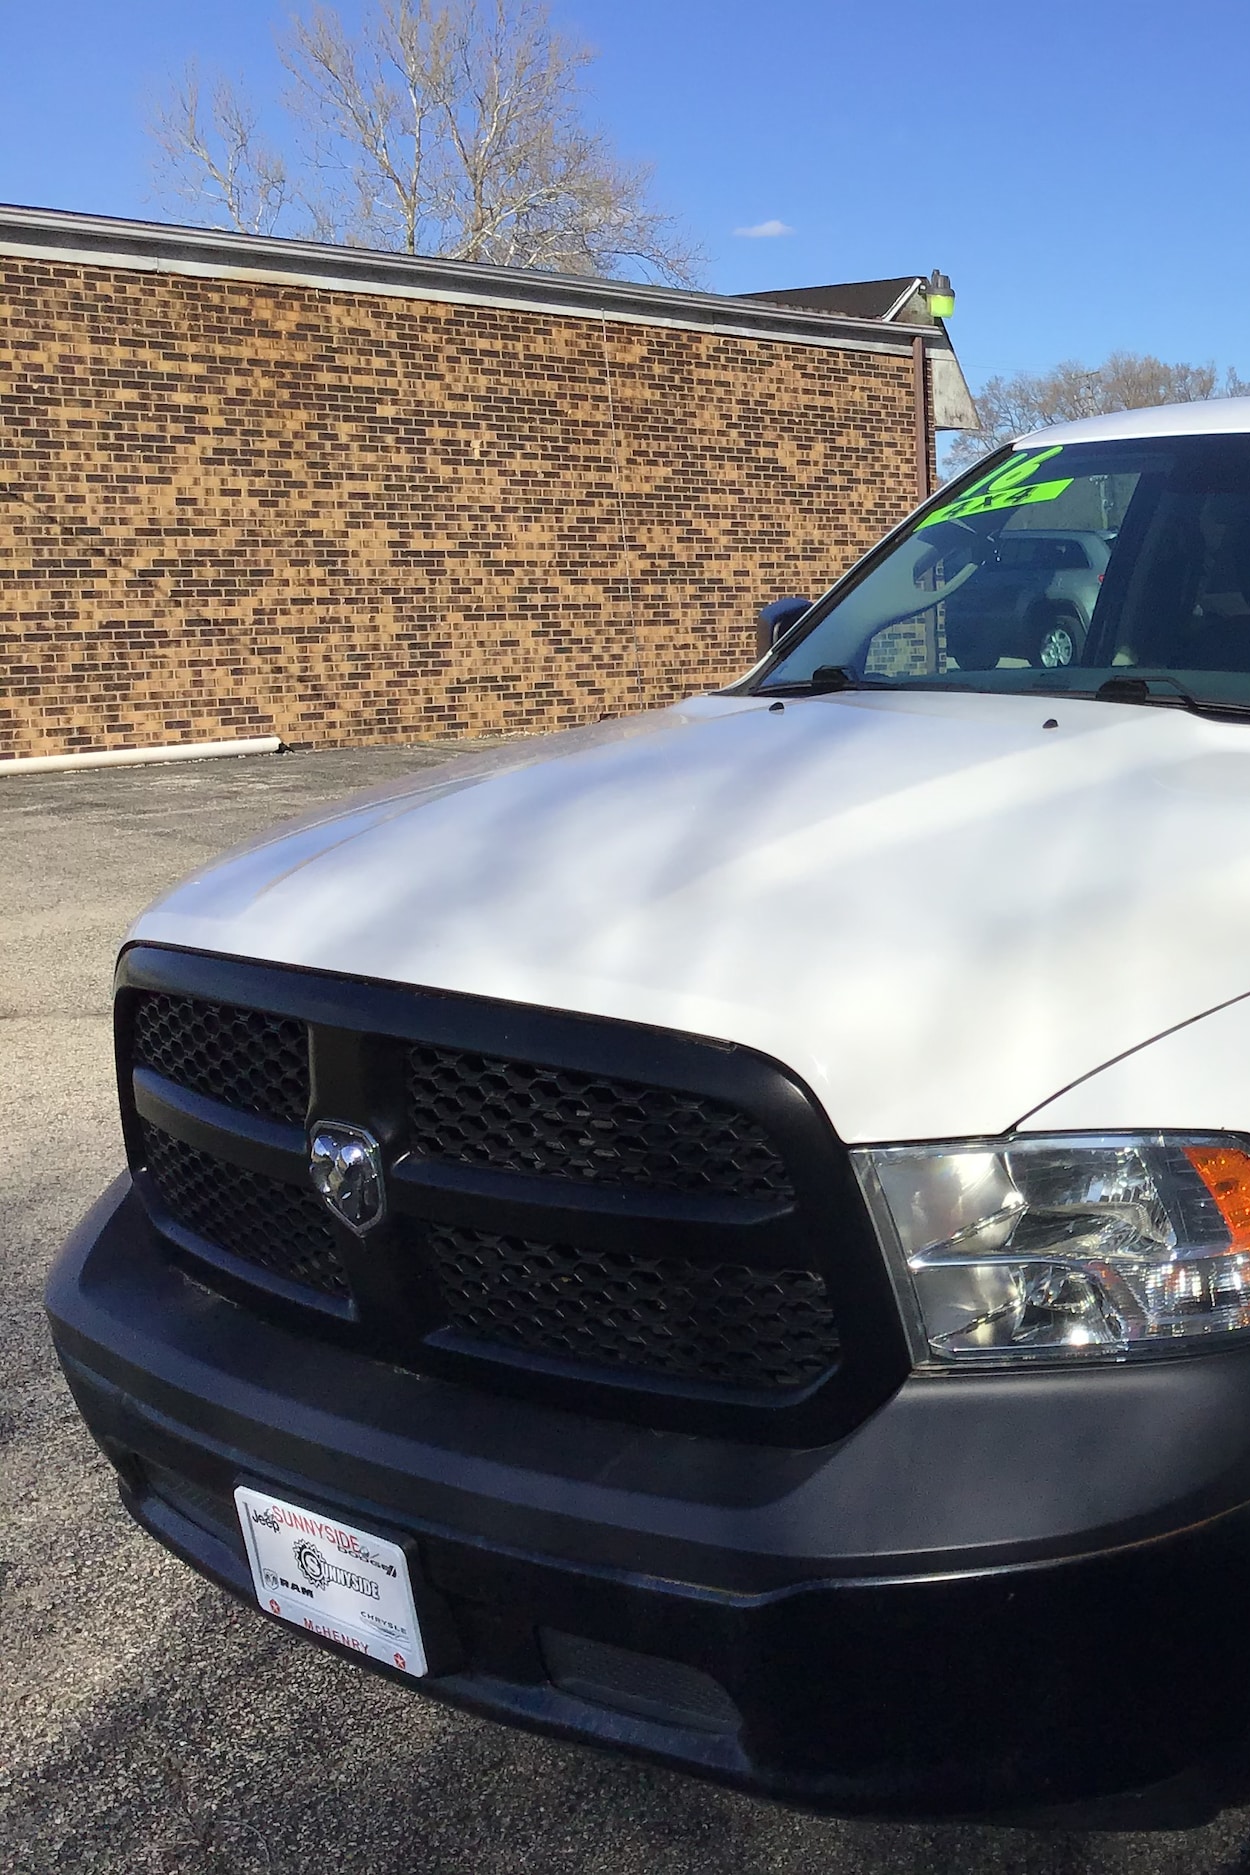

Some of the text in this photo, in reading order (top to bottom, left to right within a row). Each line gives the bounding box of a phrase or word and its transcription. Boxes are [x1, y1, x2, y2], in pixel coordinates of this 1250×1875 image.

[959, 445, 1064, 499] 16
[252, 1508, 280, 1534] Jeep
[271, 1504, 360, 1554] SUNNYSIDE
[279, 1577, 314, 1599] RAM
